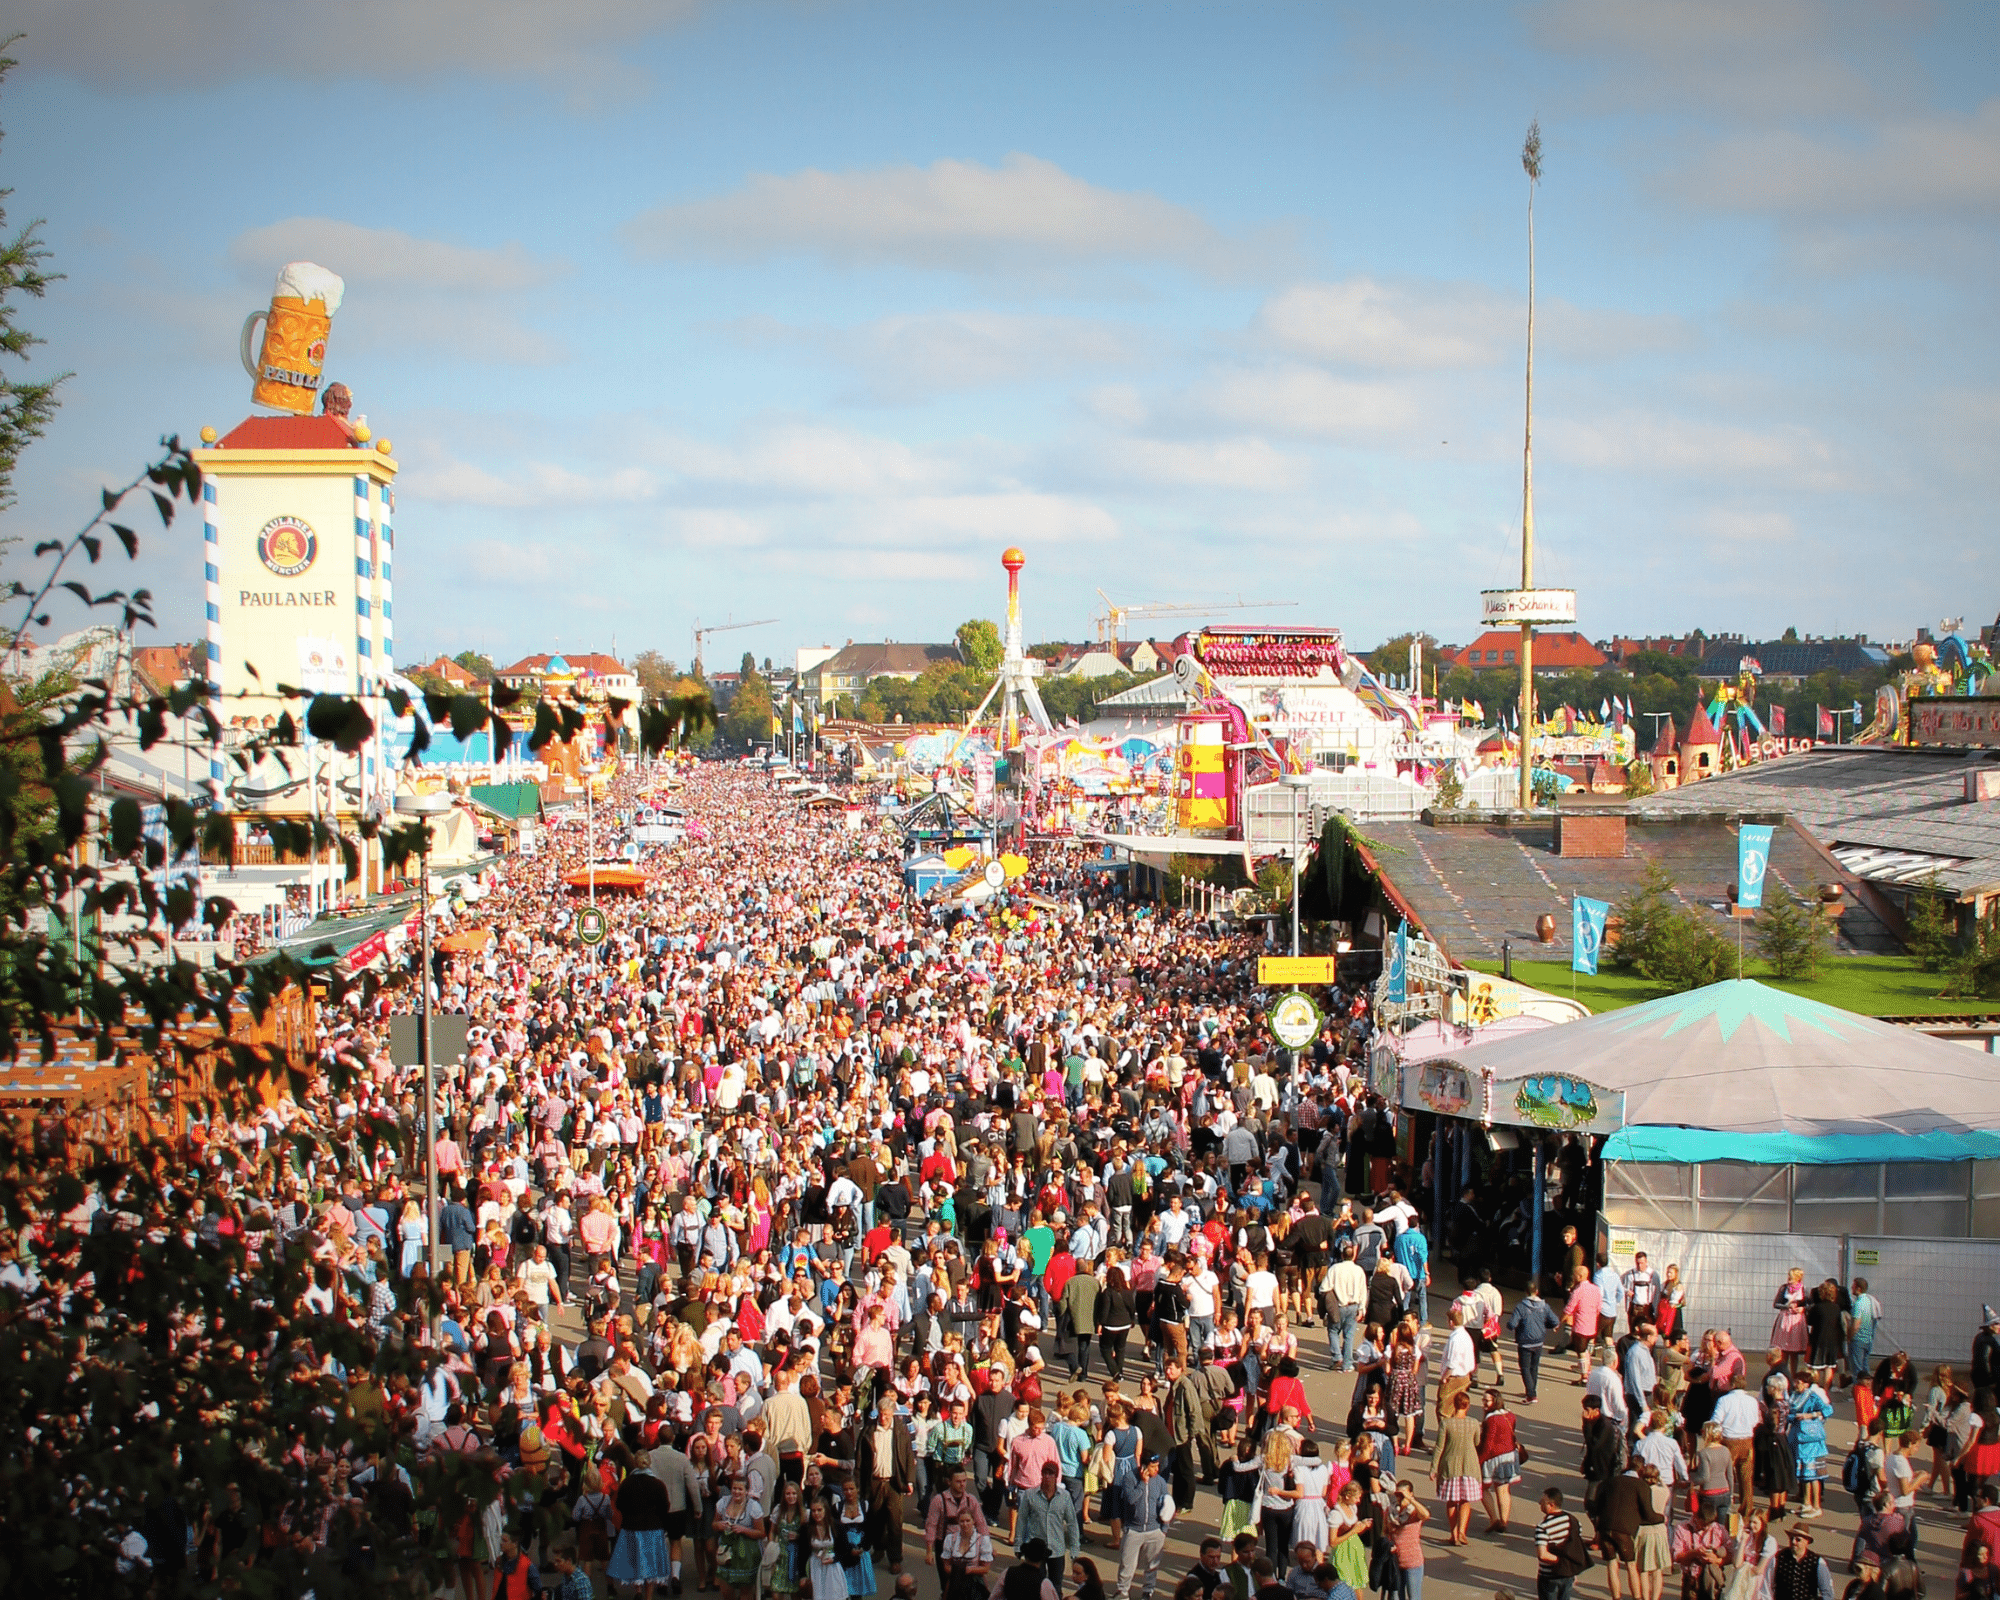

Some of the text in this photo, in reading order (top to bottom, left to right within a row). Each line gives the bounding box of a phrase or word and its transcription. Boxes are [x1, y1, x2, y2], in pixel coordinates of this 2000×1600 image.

[259, 516, 314, 540] PAULANER
[239, 590, 337, 607] PAULANER
[1749, 736, 1826, 758] SCHLO
